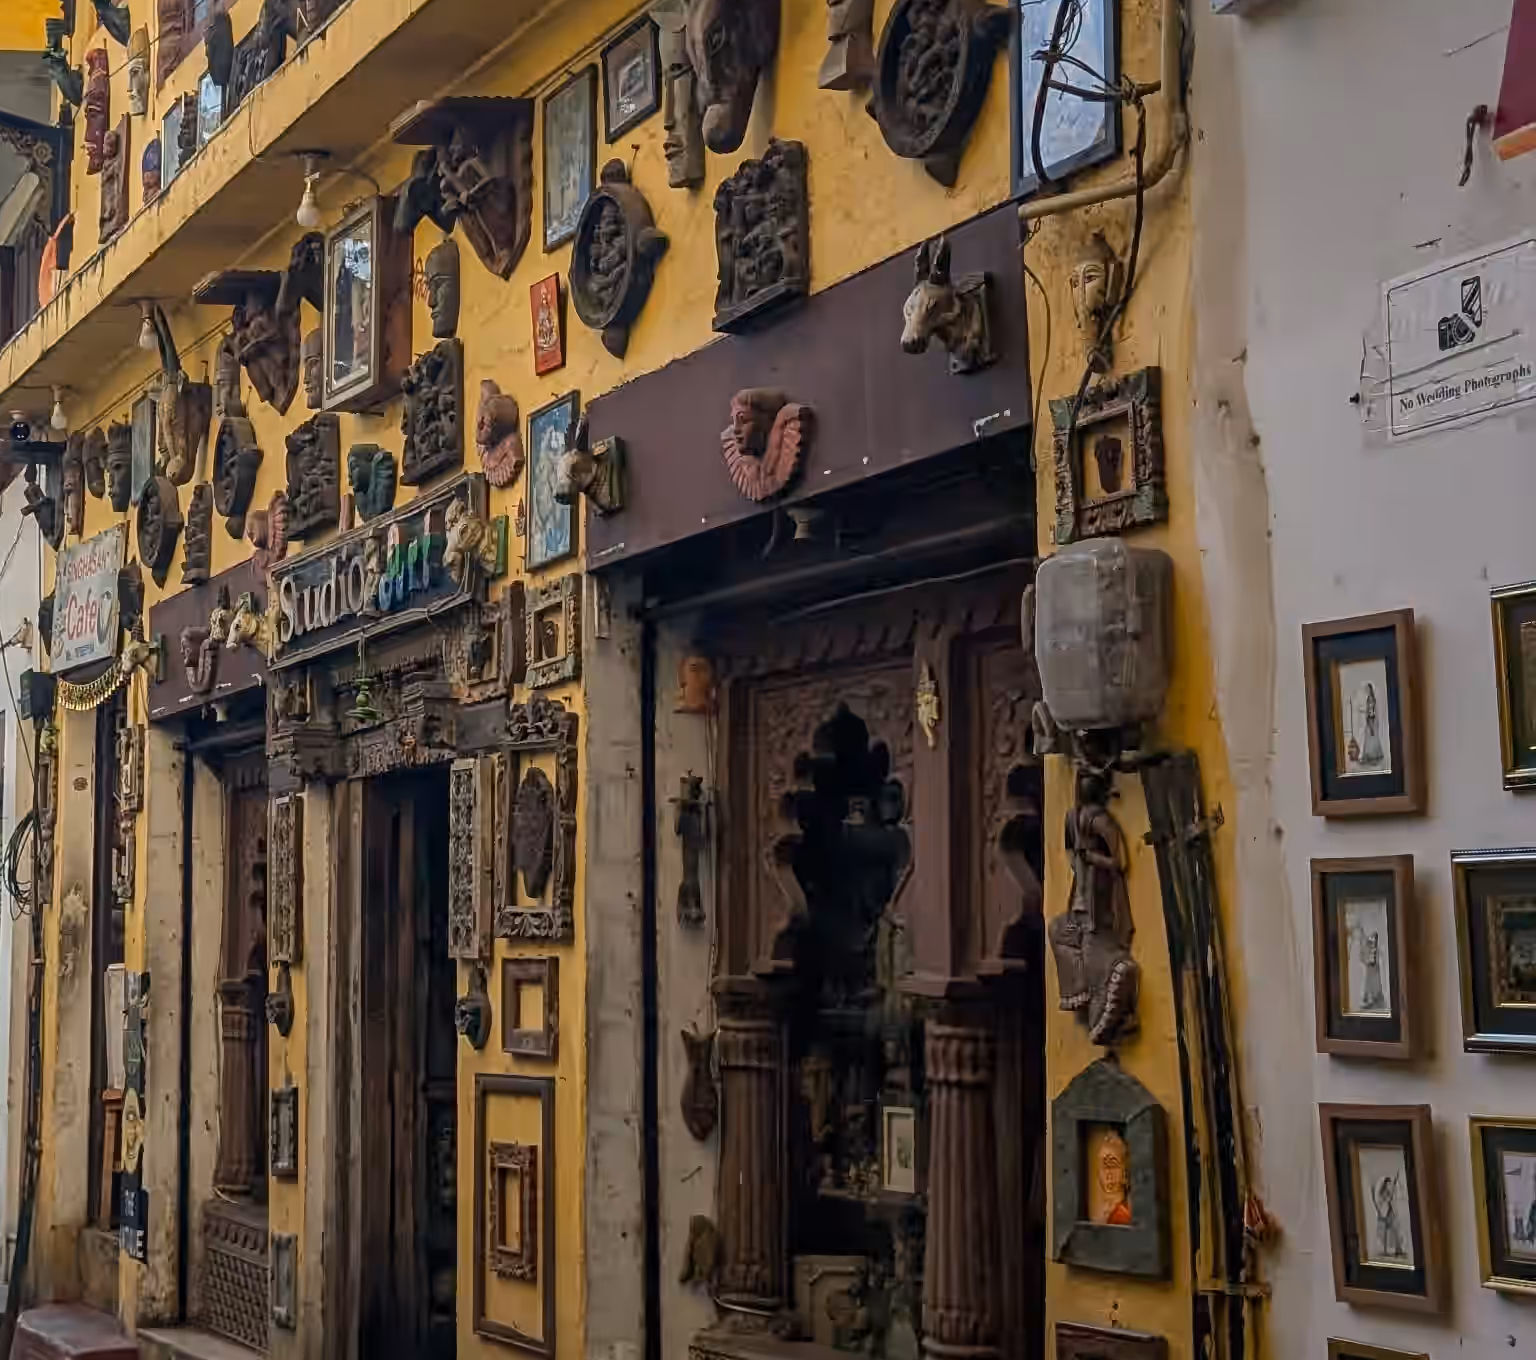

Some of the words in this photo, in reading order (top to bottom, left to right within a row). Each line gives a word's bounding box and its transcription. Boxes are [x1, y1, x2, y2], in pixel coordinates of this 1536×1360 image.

[1399, 397, 1414, 415] No
[1416, 384, 1461, 407] Wedding
[1464, 364, 1531, 393] Photographs
[279, 544, 365, 643] Studio
